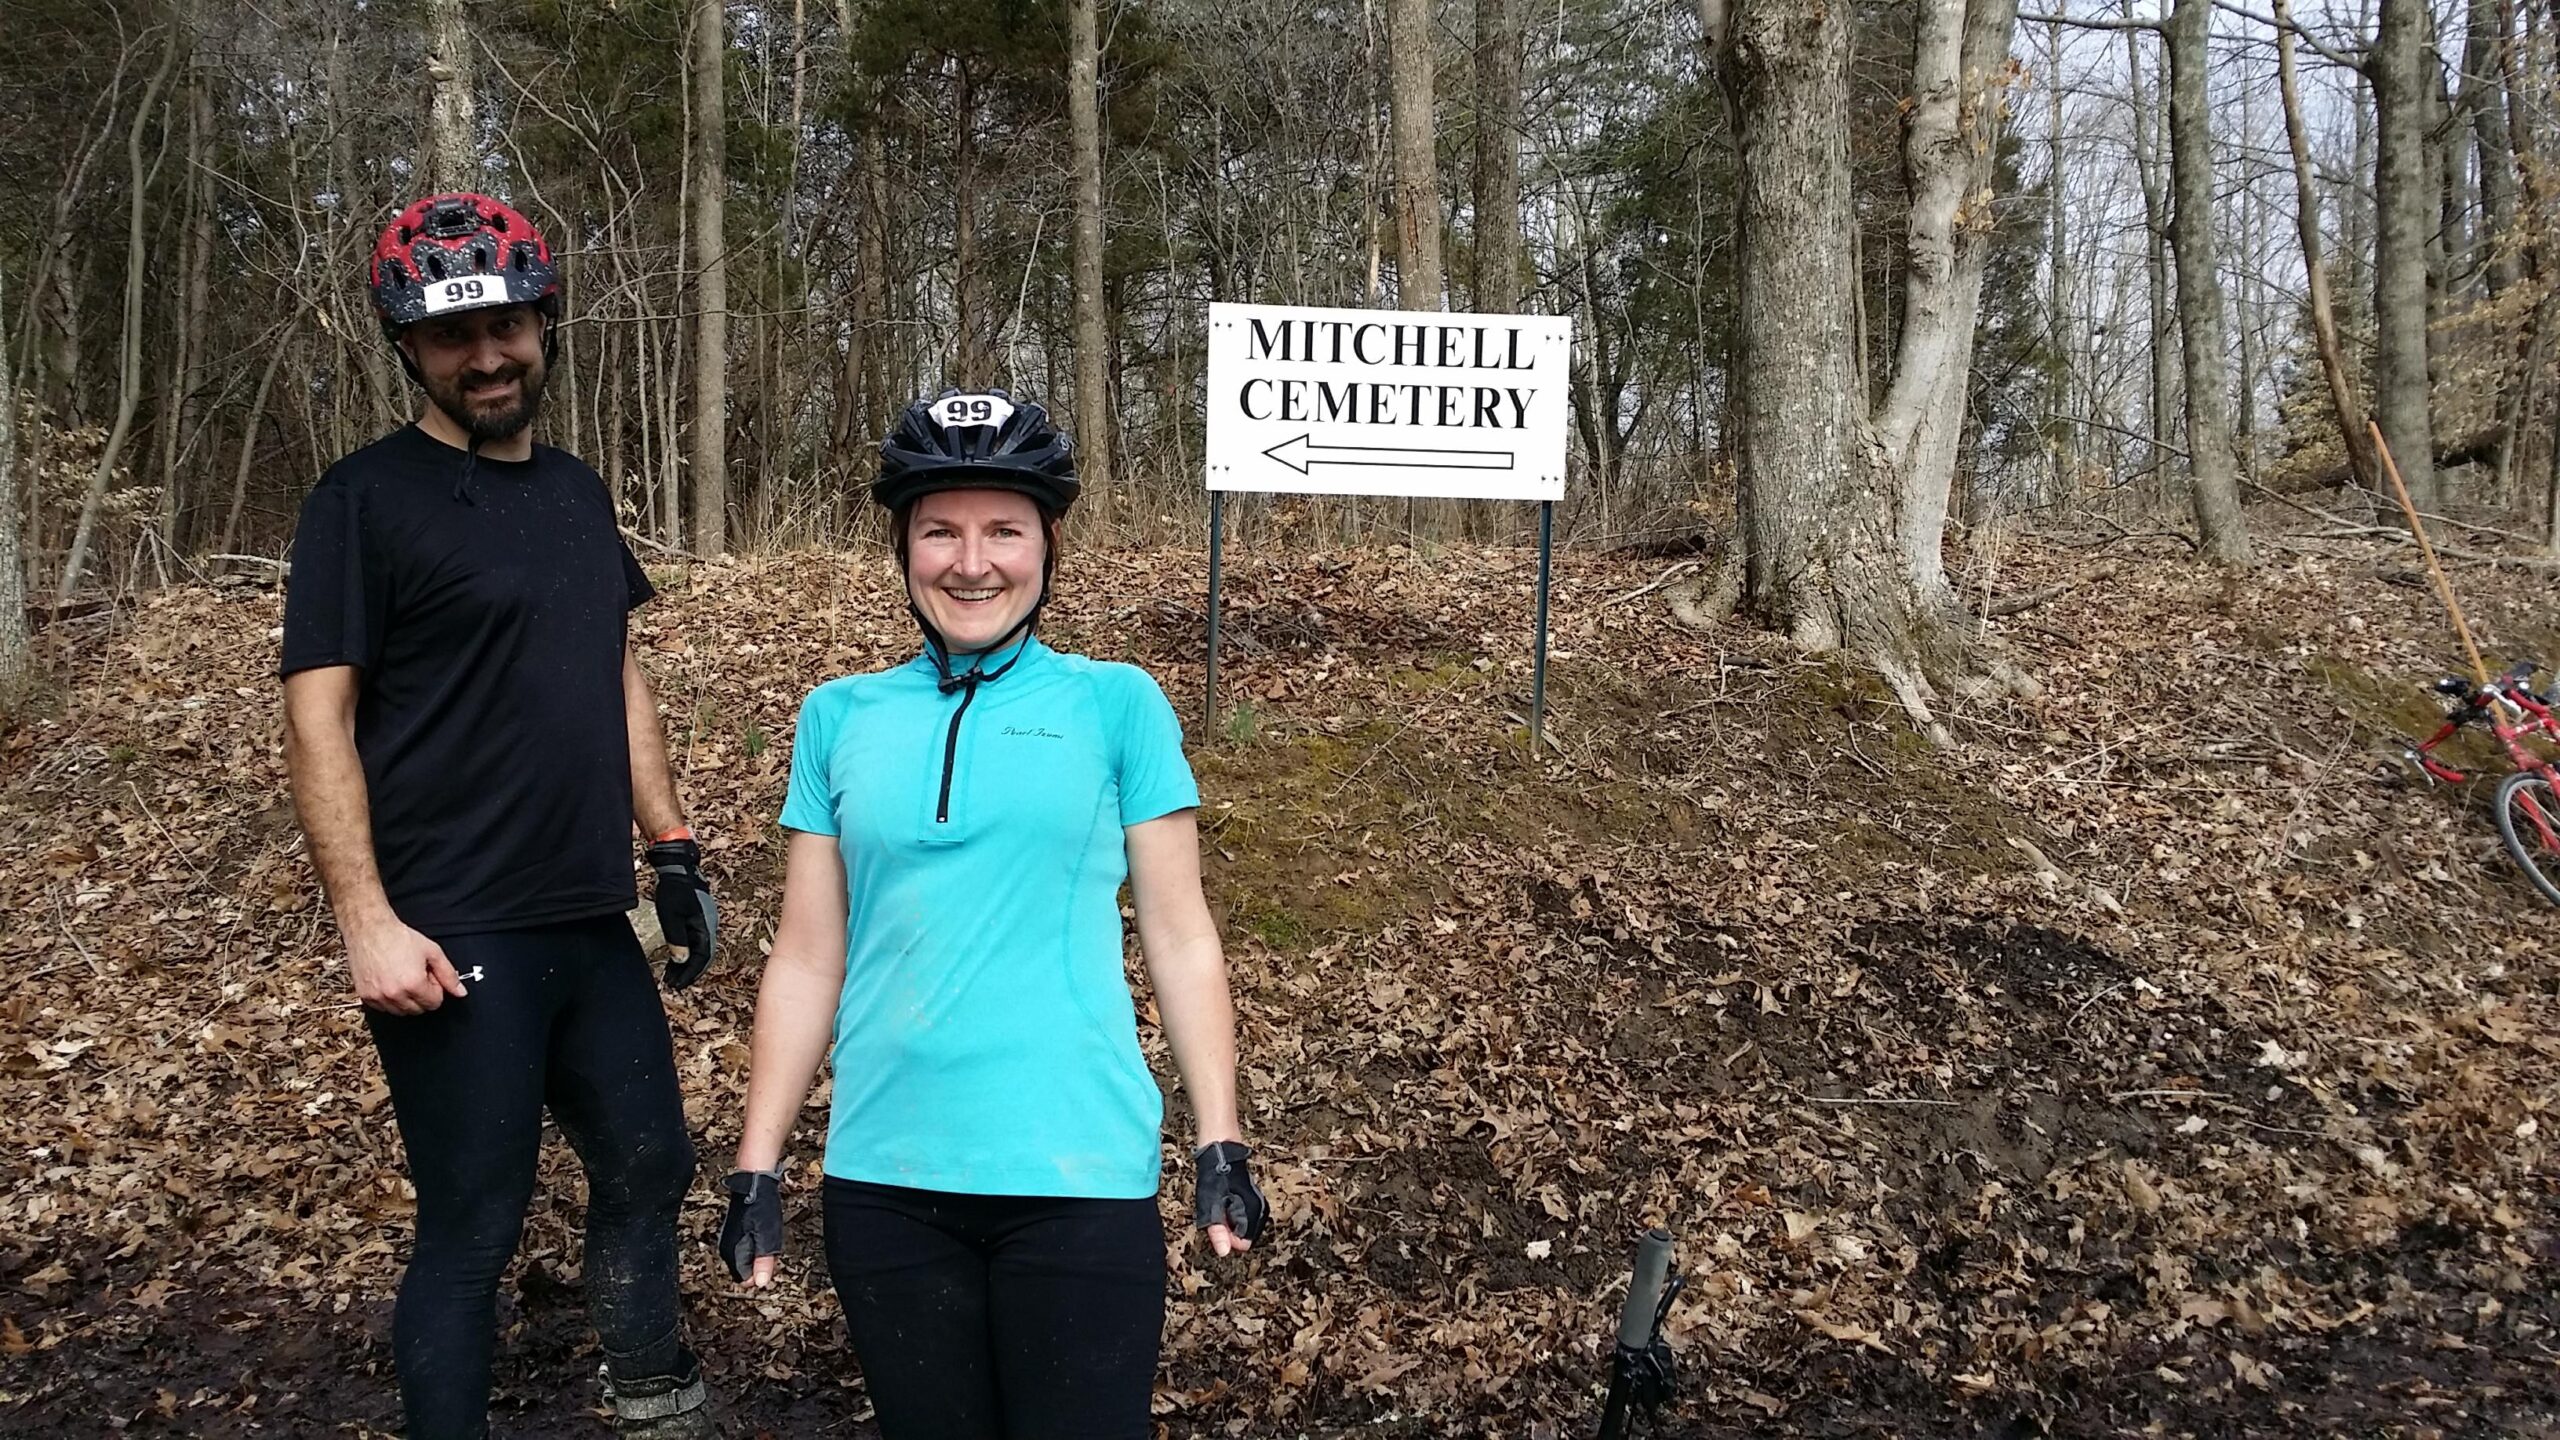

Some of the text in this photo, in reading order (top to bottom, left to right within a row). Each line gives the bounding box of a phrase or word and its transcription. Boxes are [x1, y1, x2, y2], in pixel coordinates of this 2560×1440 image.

[445, 280, 484, 302] 99
[1245, 318, 1536, 370] MITCHELL
[947, 400, 992, 422] 99
[1239, 378, 1538, 429] CEMETERY
